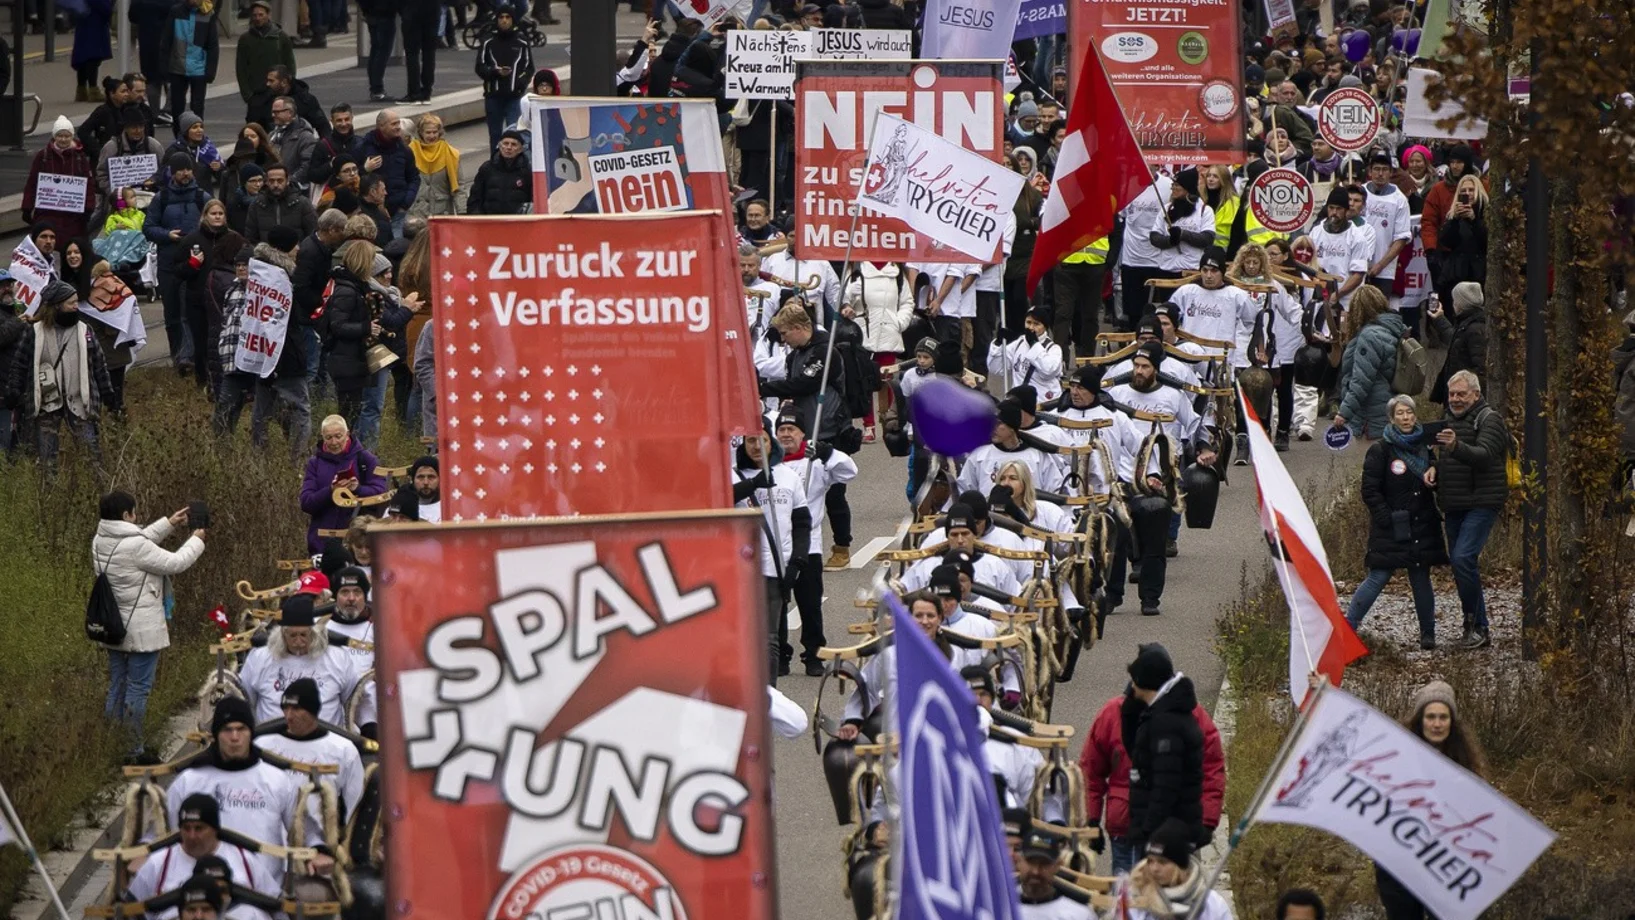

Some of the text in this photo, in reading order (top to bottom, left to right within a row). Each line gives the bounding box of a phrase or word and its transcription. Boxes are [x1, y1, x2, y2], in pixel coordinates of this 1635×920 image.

[710, 6, 727, 20] NEIN
[939, 5, 995, 28] JESUS
[1126, 8, 1187, 22] JETZT!
[817, 31, 862, 53] JESUS
[728, 54, 763, 73] Kreuz
[765, 64, 781, 73] am
[783, 55, 795, 73] Hi
[1146, 73, 1203, 81] Organisationen
[1326, 91, 1353, 106] COVID-19
[1322, 105, 1376, 124] NEIN
[593, 150, 672, 174] COVID-GESETZ
[803, 166, 838, 185] zu
[906, 150, 1007, 216] helvetia
[1271, 171, 1300, 183] COVID-19
[597, 170, 682, 214] nein
[1254, 185, 1309, 204] NON
[906, 180, 997, 243] TRYCHLER
[804, 224, 916, 250] Medien
[488, 242, 625, 280] Zurück
[636, 249, 698, 278] zur
[490, 287, 711, 333] Verfassung
[425, 541, 717, 703] SPAL
[1331, 771, 1483, 902] TRYCHLER
[505, 856, 583, 919] COVID-19
[583, 855, 650, 894] Gesetz
